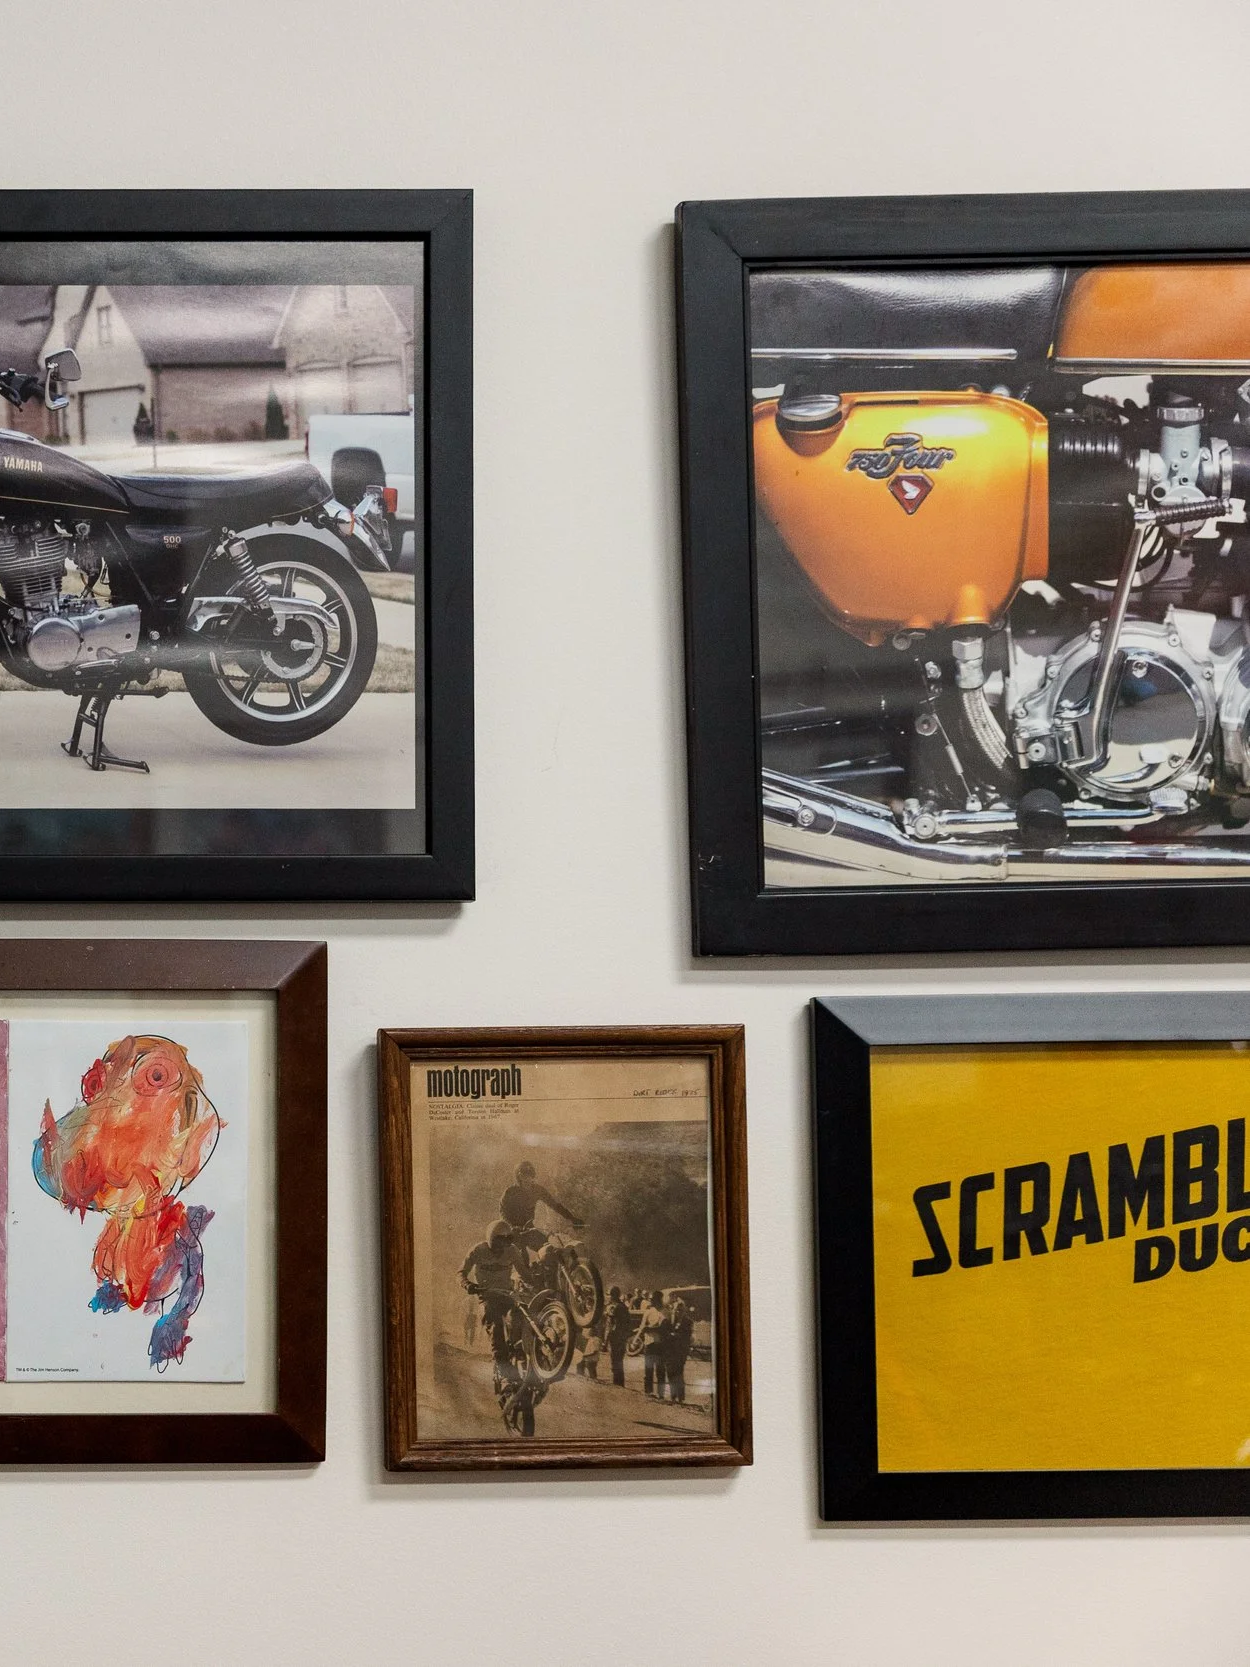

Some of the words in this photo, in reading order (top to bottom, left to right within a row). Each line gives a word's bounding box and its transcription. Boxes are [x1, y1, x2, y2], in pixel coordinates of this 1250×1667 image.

[3, 456, 44, 473] YAMAHA
[163, 535, 182, 544] 500
[426, 1063, 522, 1099] motograph
[912, 1117, 1250, 1278] SCRAMBL
[1133, 1215, 1250, 1284] DUC
